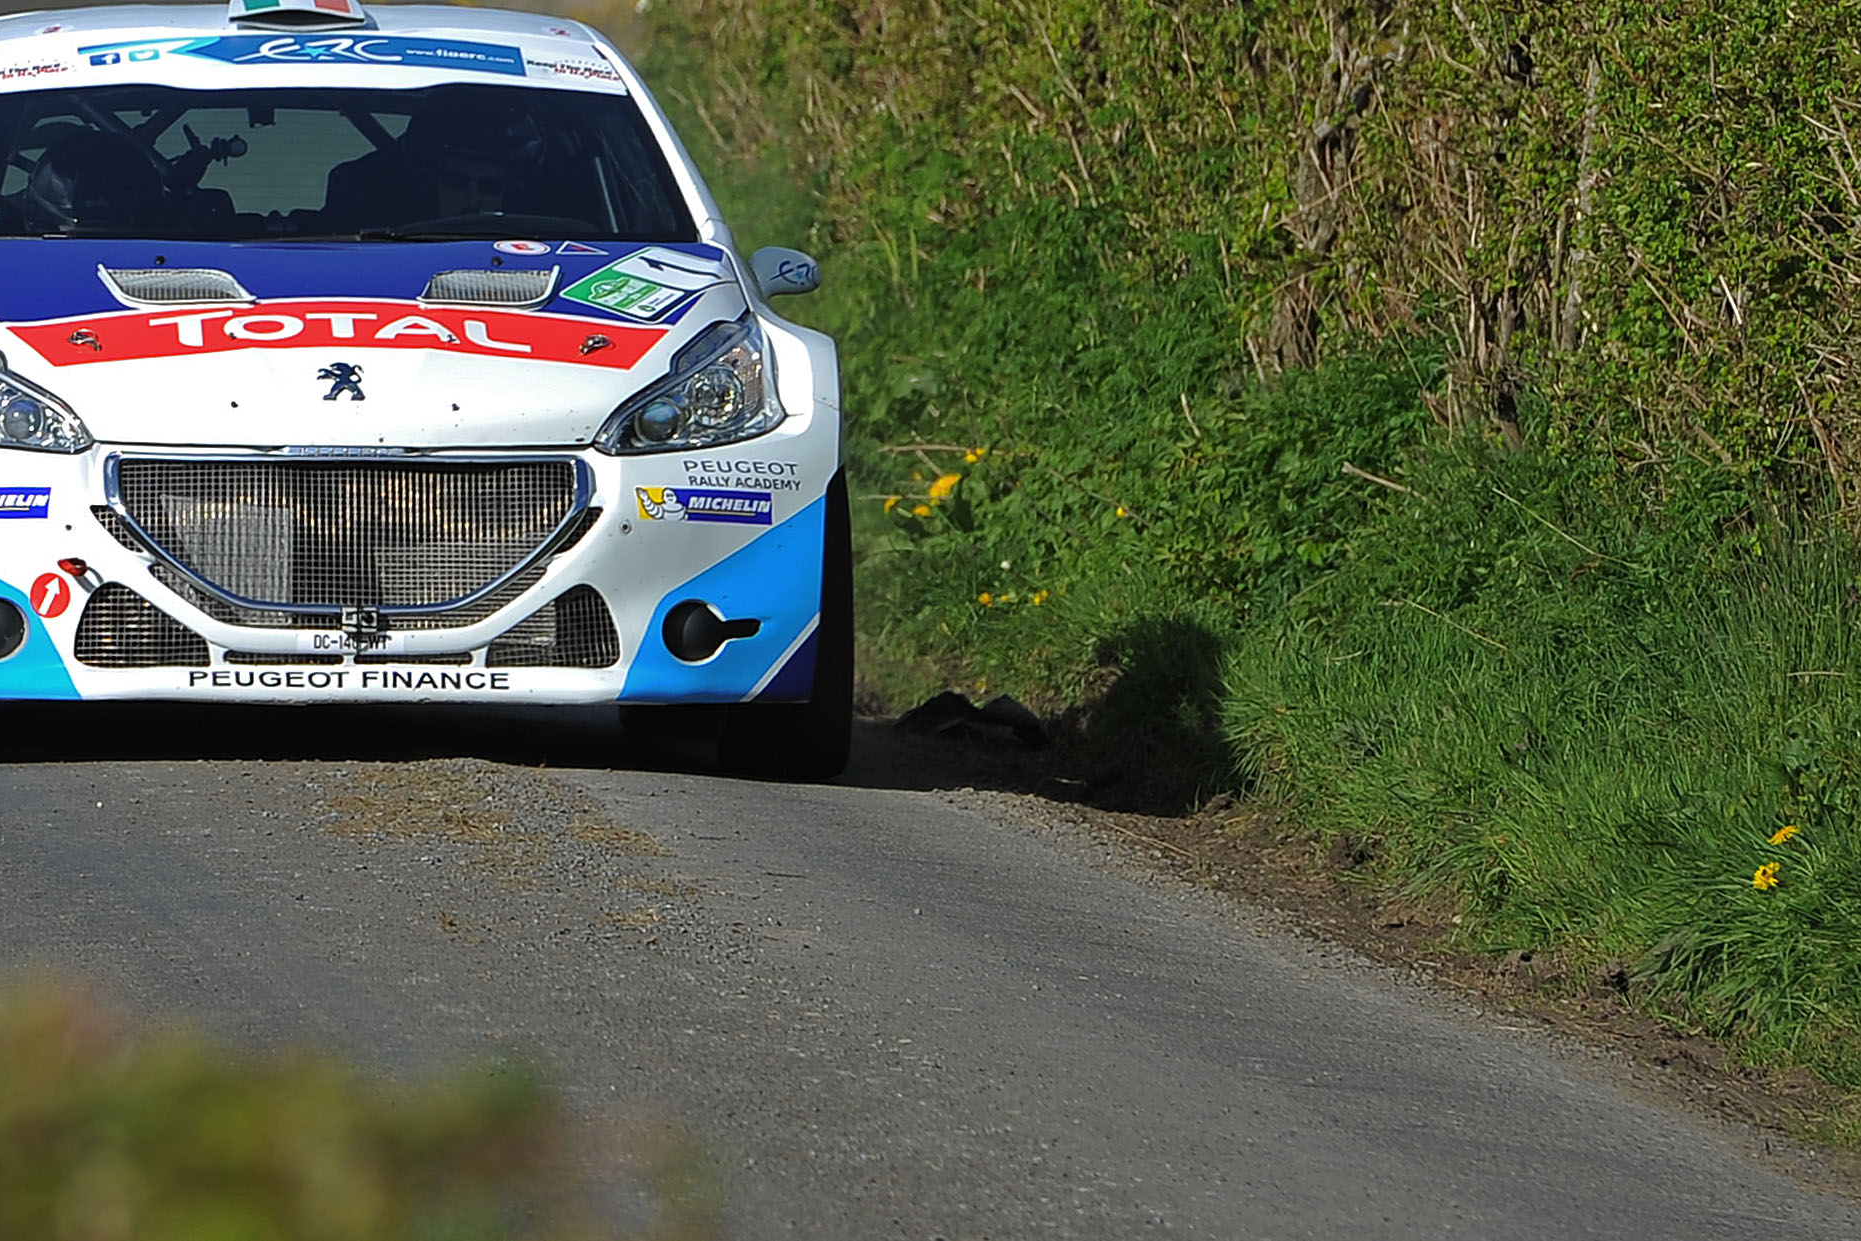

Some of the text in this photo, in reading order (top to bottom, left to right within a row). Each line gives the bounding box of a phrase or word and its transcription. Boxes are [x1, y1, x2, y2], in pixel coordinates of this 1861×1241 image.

[148, 309, 532, 353] TOTAL
[683, 459, 799, 476] PEUGEOT
[688, 475, 802, 491] RALLY ACADEMY
[687, 496, 773, 514] MICHELIN
[189, 671, 511, 690] PEUGEOT FINANCE
